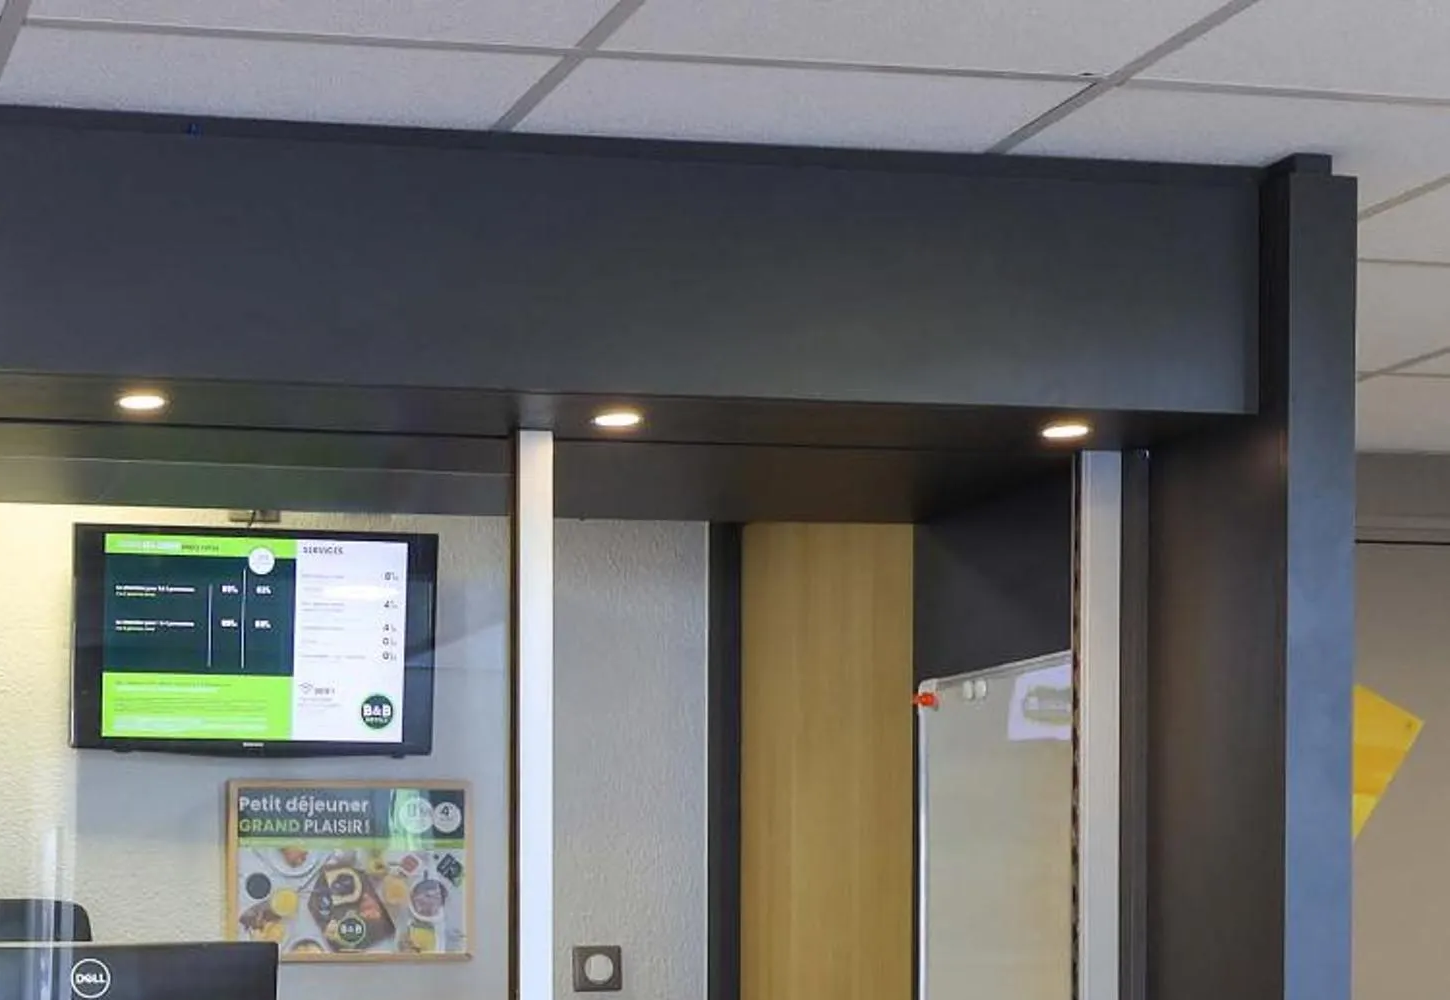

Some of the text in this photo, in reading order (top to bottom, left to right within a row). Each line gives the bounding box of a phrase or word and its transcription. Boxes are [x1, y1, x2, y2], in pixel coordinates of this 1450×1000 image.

[362, 703, 392, 717] B&B
[238, 795, 370, 818] Petit déjeuner
[238, 818, 301, 834] GRAND
[75, 973, 107, 984] DELL
